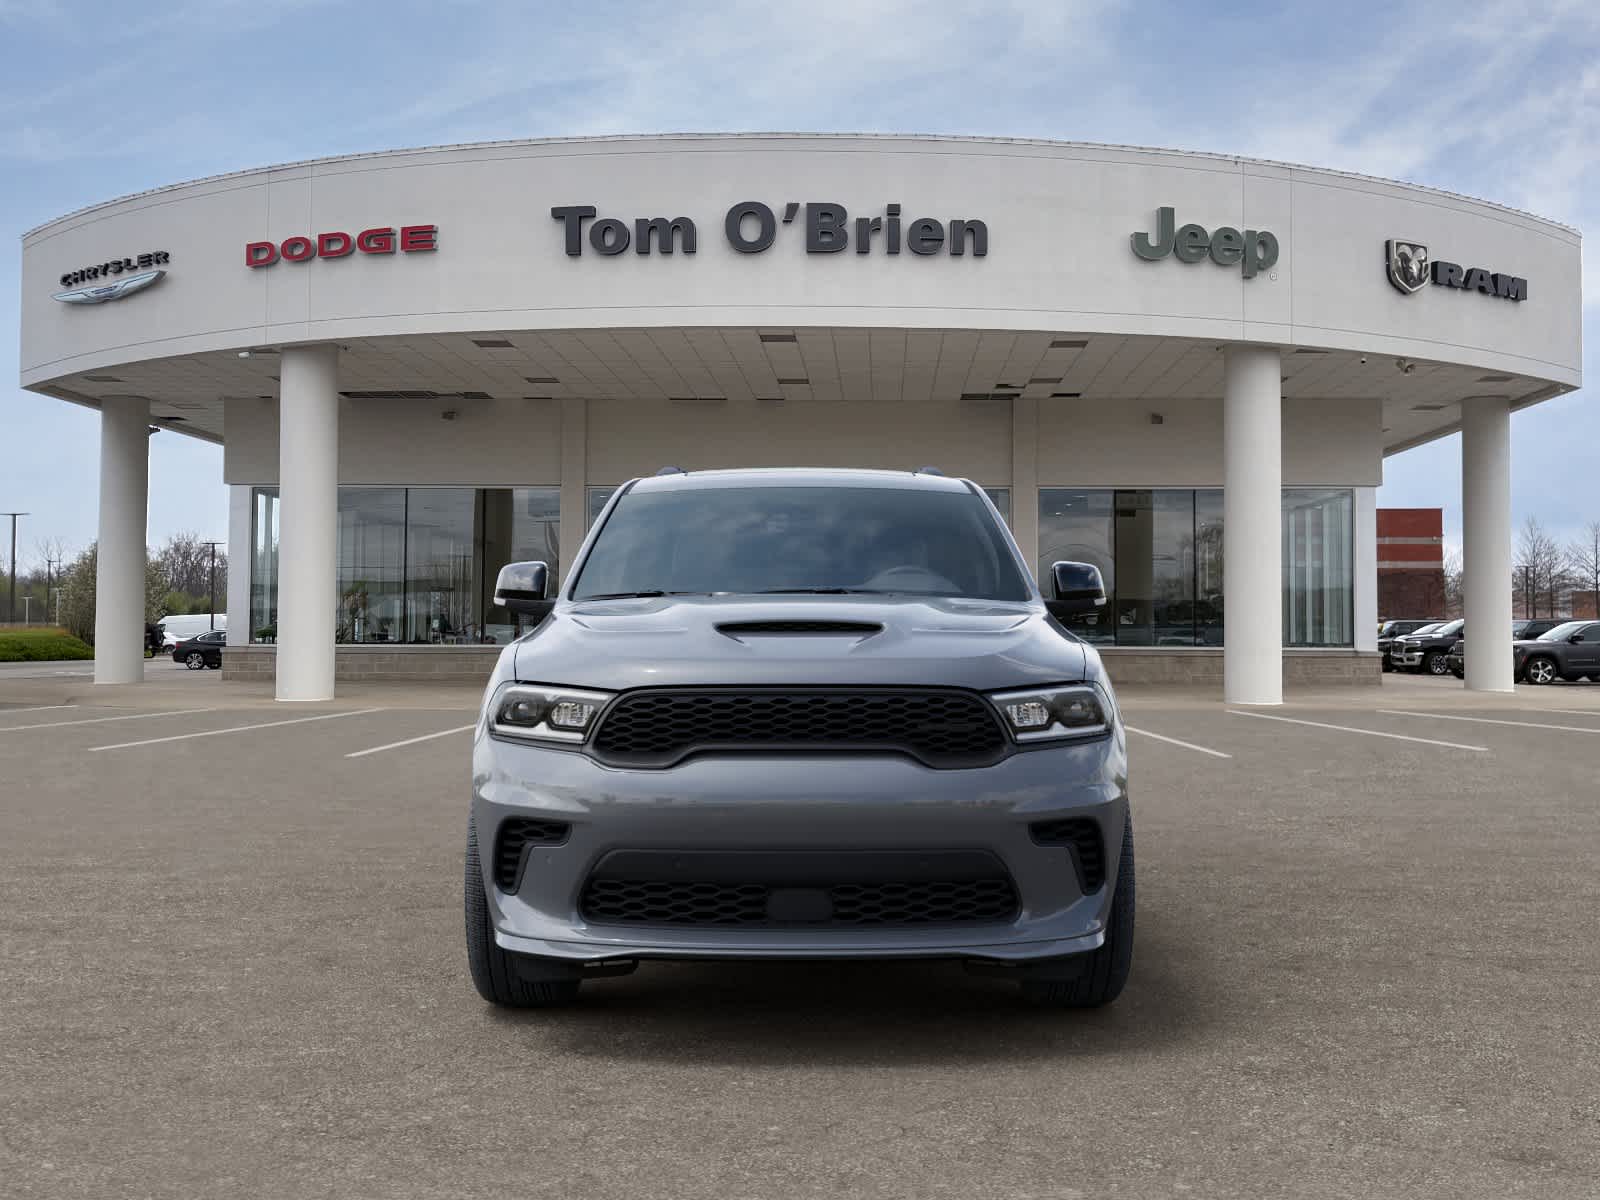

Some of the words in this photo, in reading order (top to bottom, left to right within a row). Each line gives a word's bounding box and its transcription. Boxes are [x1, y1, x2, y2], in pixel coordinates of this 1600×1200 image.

[245, 224, 438, 269] DODGE
[551, 205, 697, 256] Tom
[724, 201, 988, 256] O'Brien
[1130, 206, 1279, 279] Jeep
[60, 250, 170, 287] CHRYSLER
[1430, 260, 1528, 301] RAM
